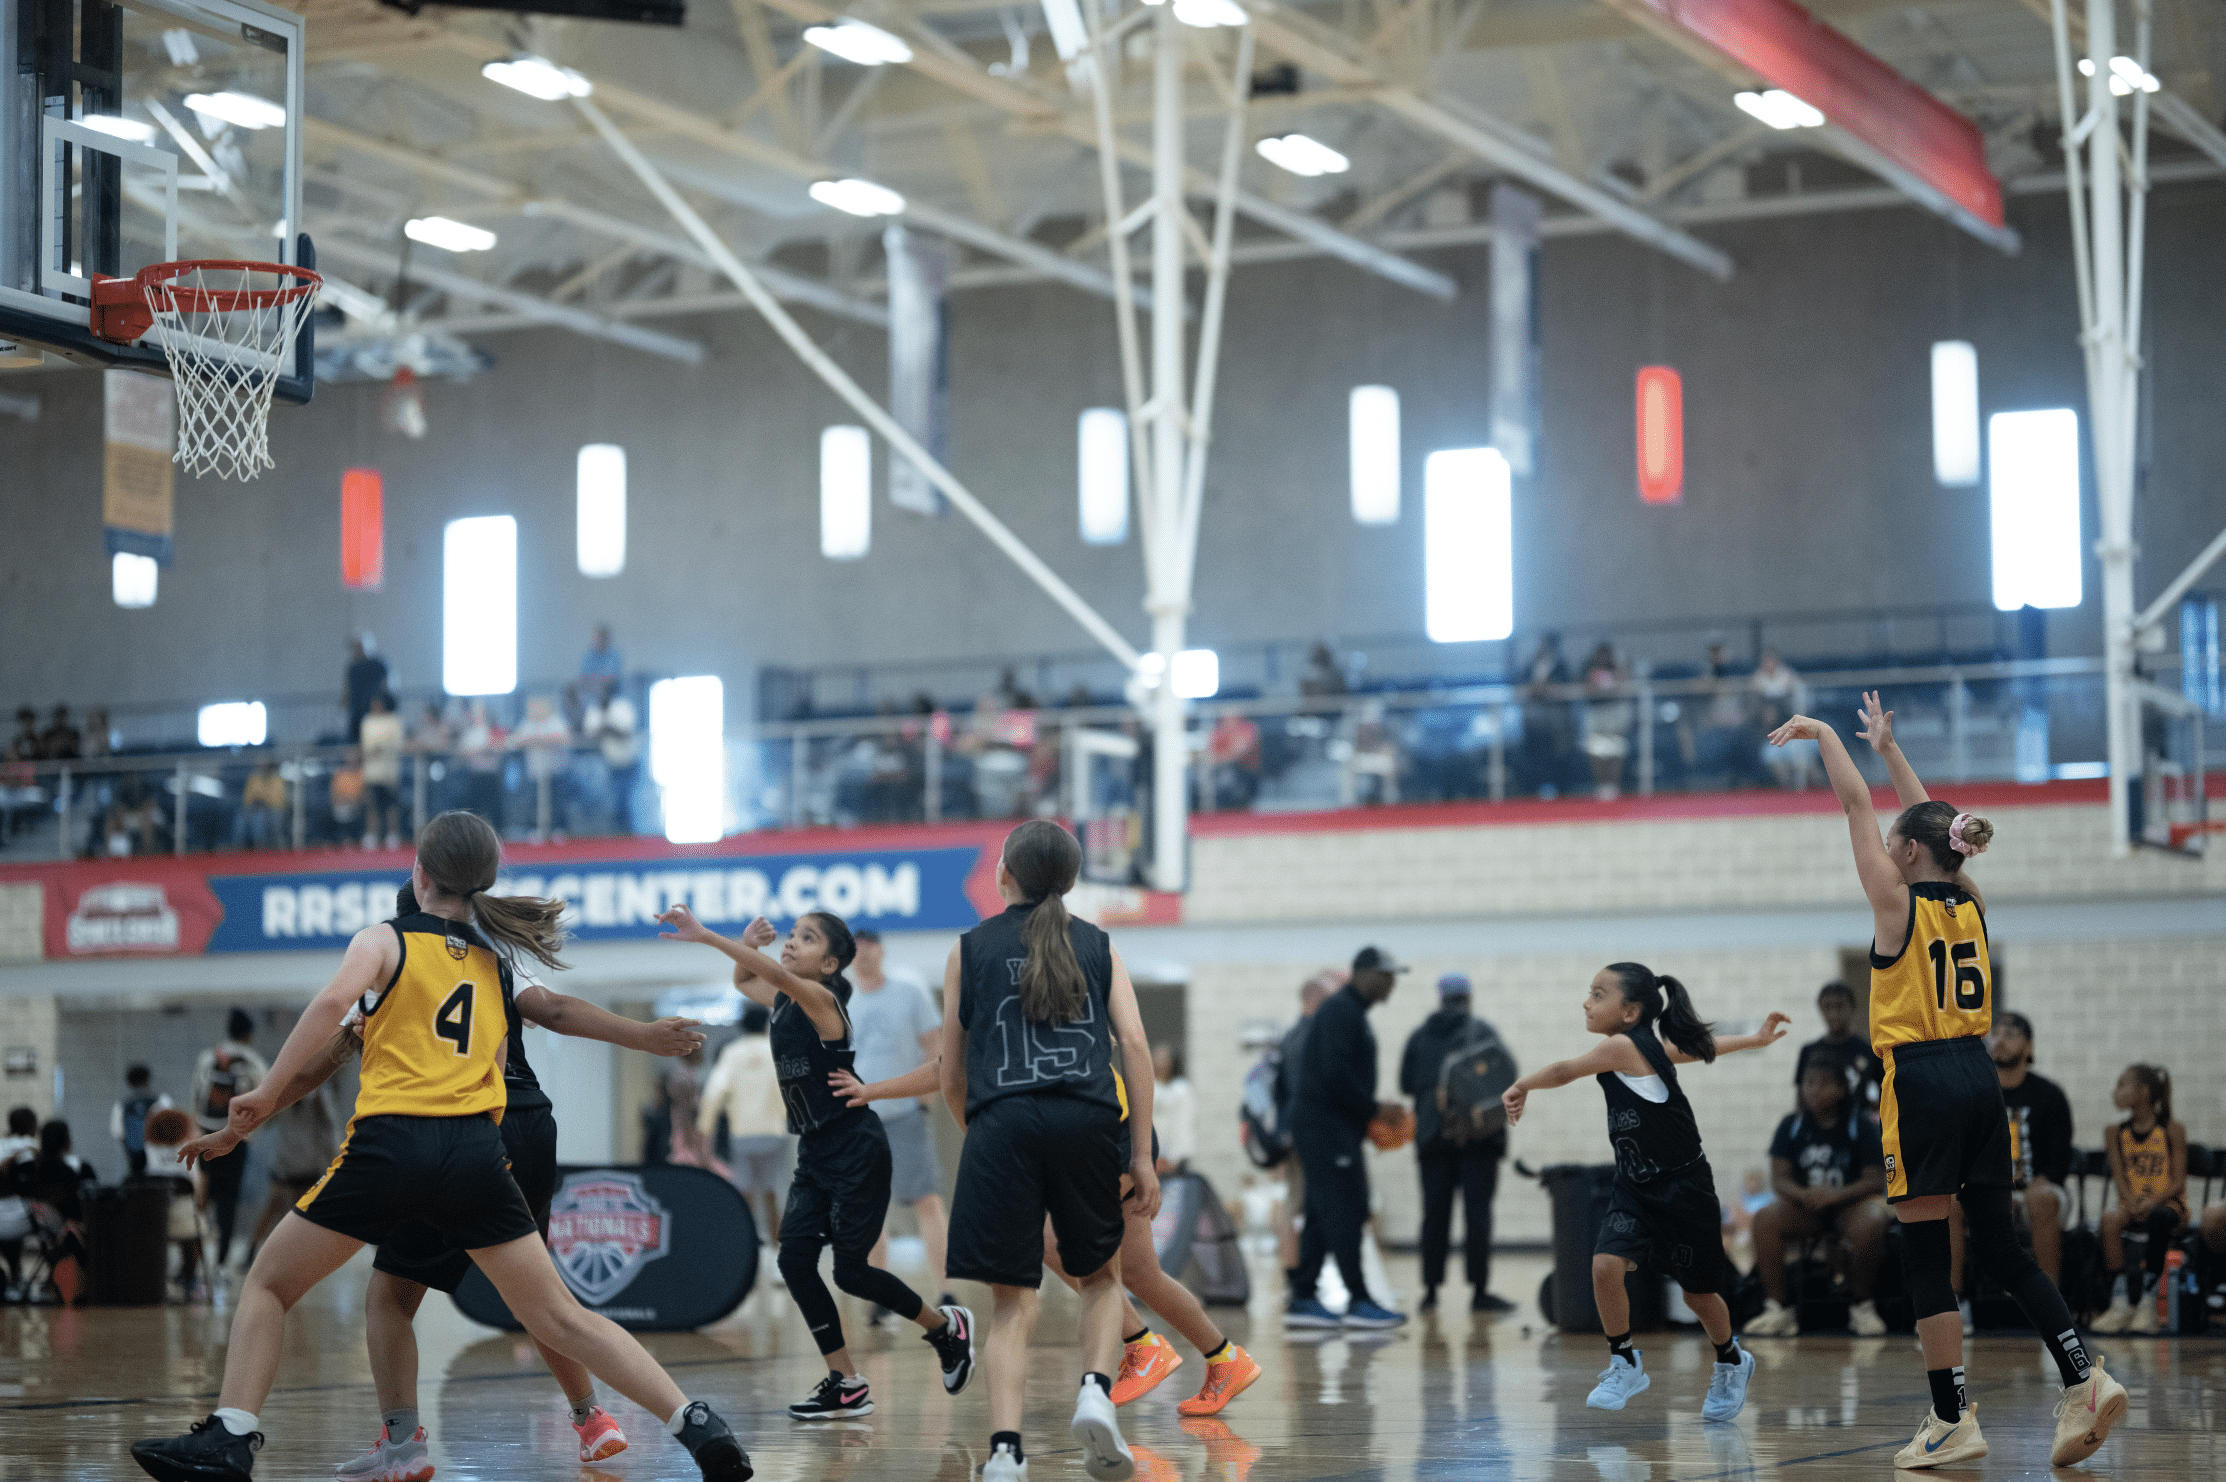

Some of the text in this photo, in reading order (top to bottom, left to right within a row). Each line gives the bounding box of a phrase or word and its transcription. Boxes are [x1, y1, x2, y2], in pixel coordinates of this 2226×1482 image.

[1926, 937, 1987, 1013] 16
[432, 980, 476, 1058] 4
[996, 992, 1096, 1087] 15
[1957, 1385, 1967, 1410] 1
[2068, 1347, 2091, 1373] 6
